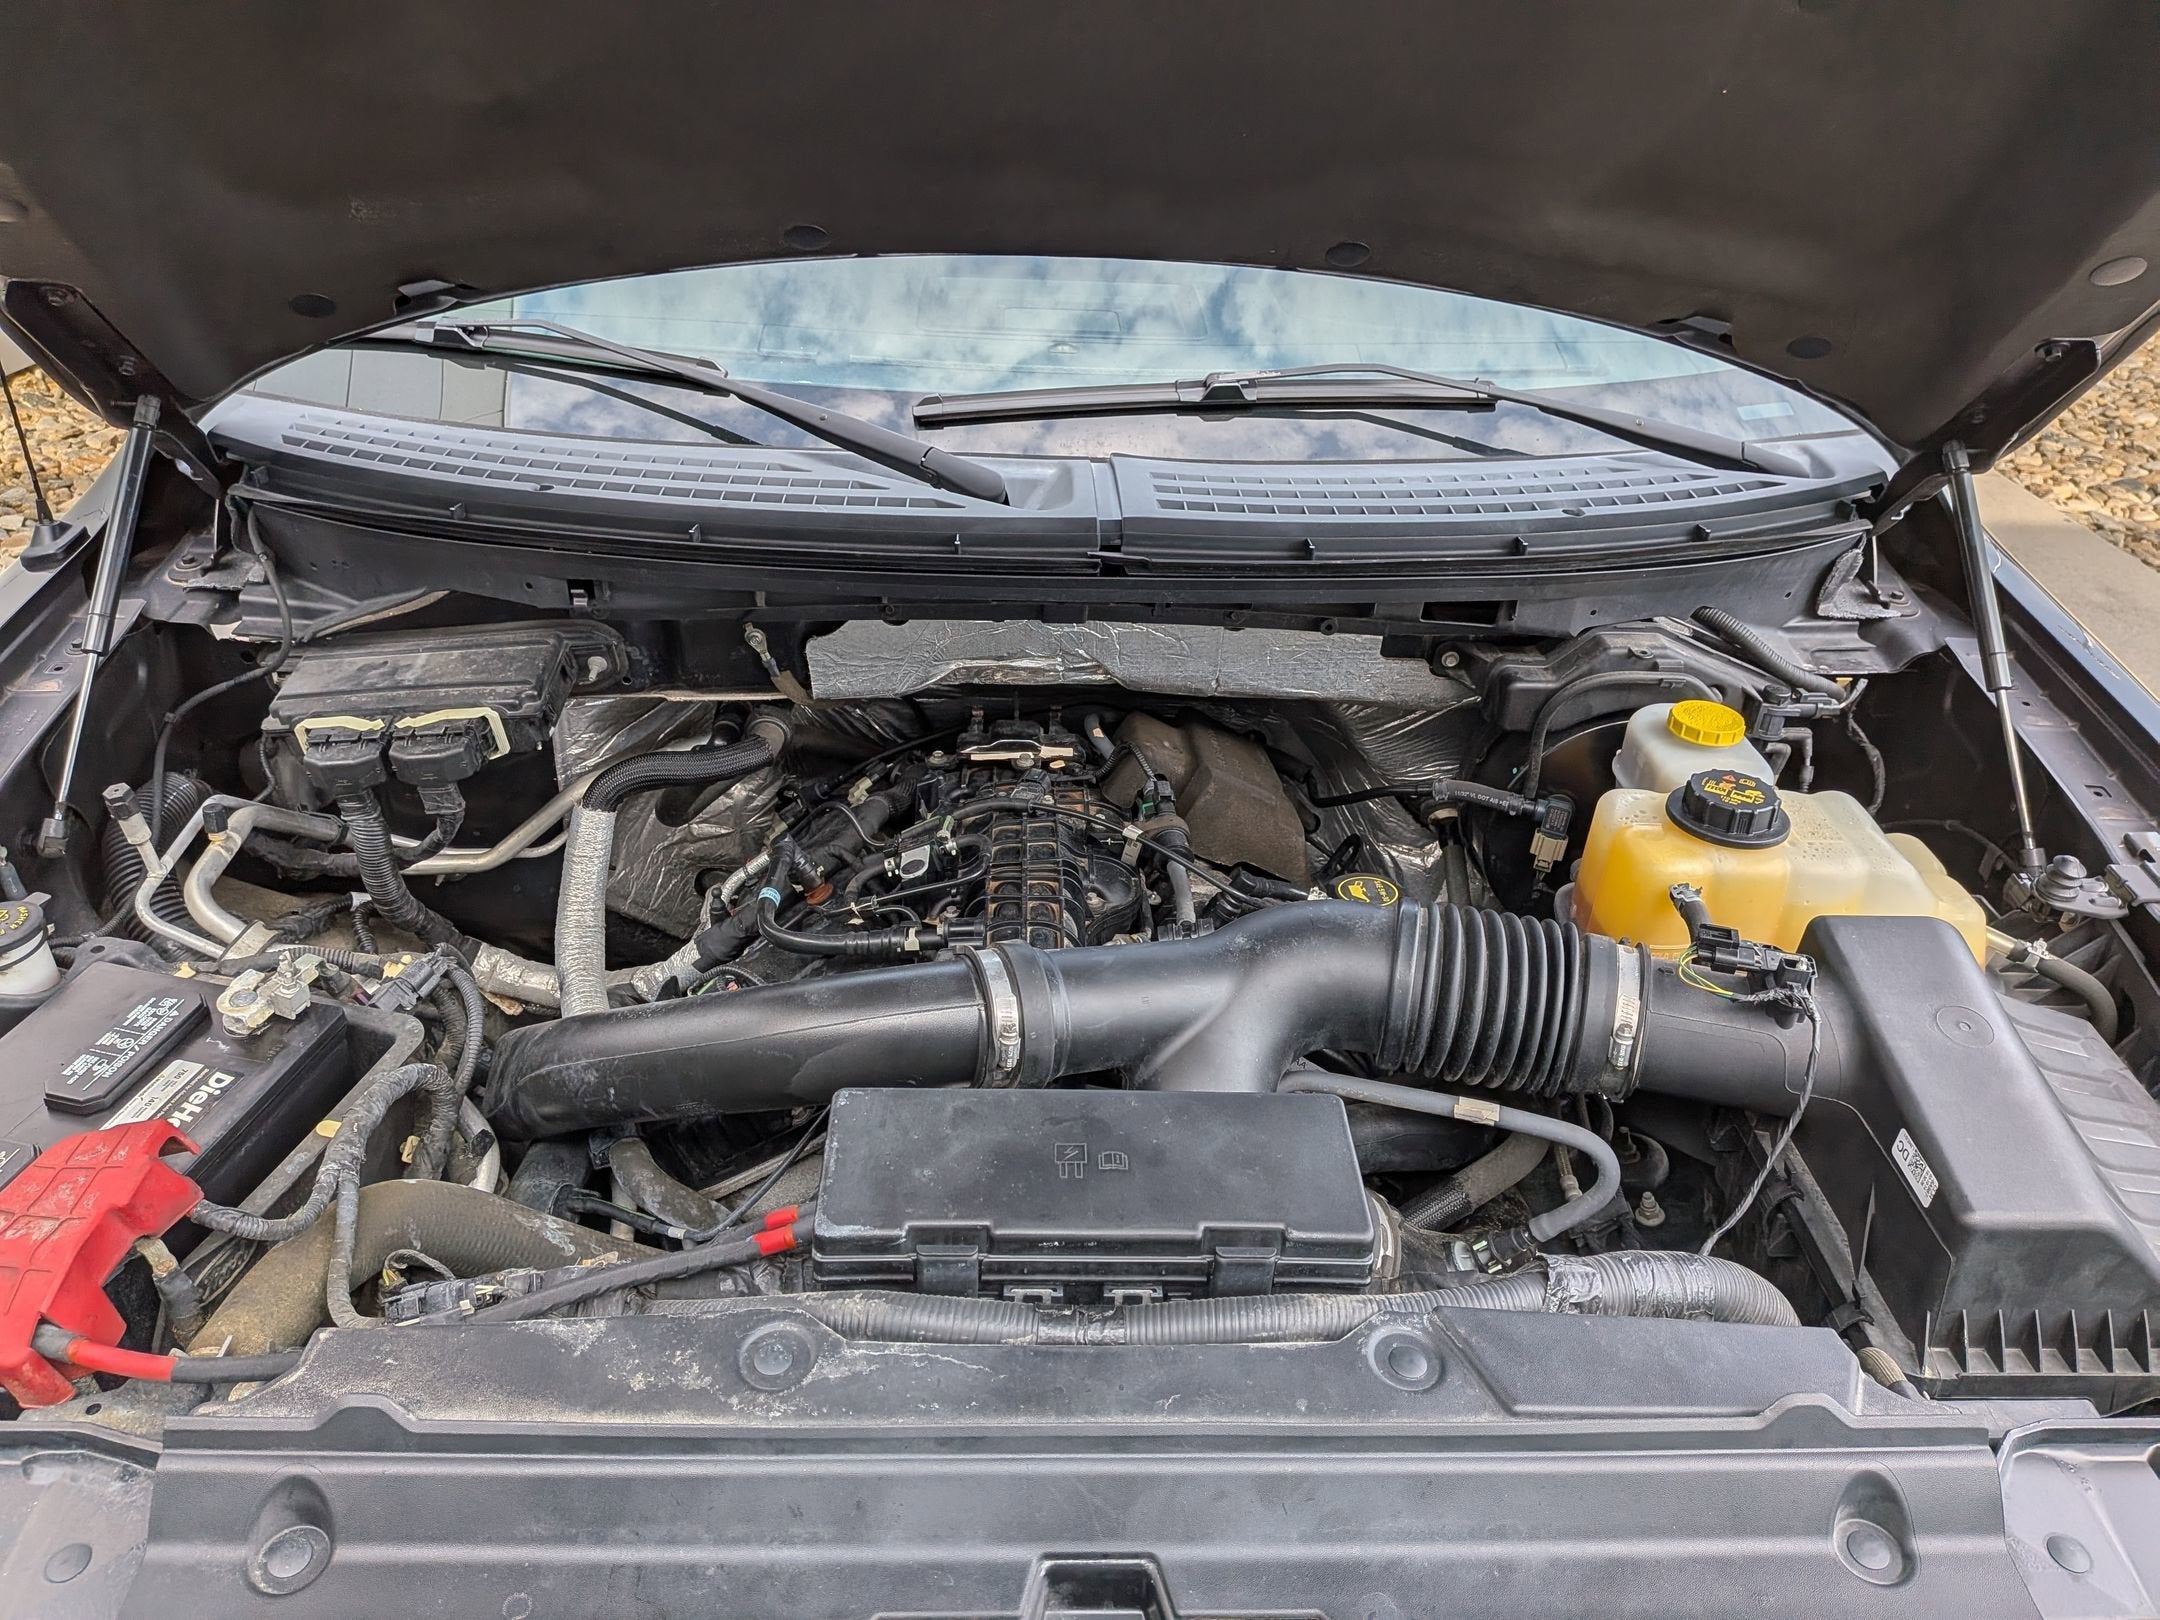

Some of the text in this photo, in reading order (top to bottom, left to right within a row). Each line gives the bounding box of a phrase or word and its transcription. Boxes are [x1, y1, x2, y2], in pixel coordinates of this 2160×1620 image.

[1477, 793, 1490, 802] DOT
[138, 1017, 174, 1046] DANGER
[102, 1051, 136, 1078] POISON
[1897, 1140, 1910, 1162] DC
